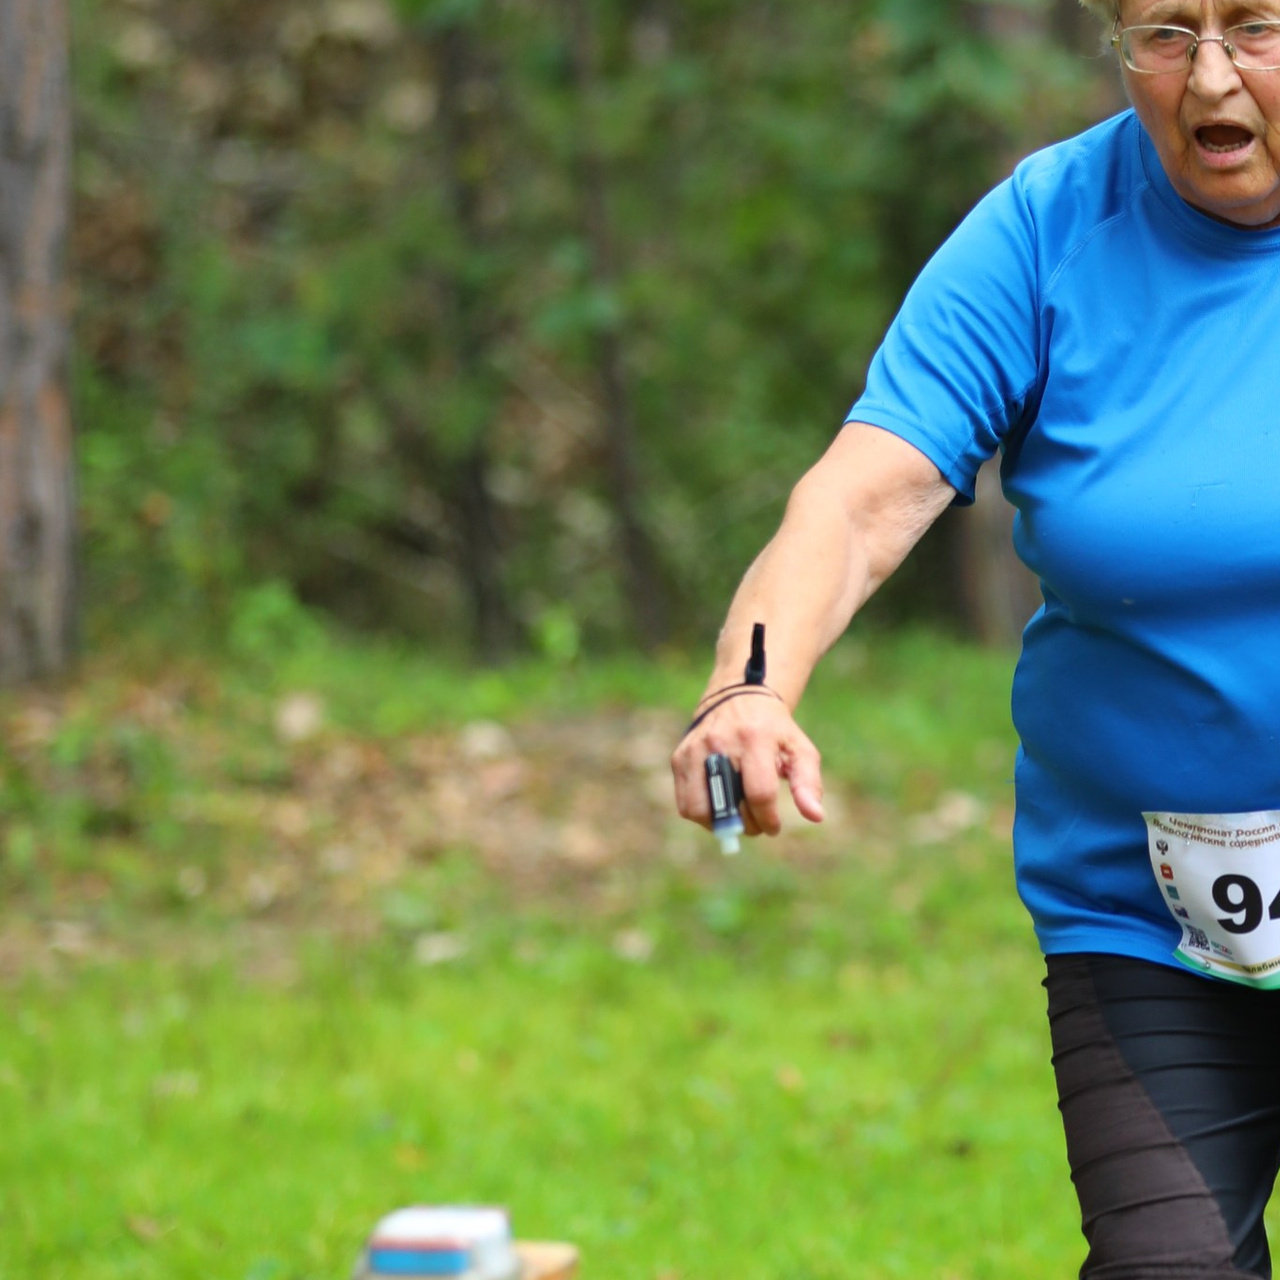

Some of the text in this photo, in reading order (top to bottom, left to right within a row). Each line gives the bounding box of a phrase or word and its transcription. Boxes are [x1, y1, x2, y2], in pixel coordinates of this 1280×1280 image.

[1153, 818, 1226, 847] Всероссийские
[1169, 817, 1232, 838] Чемпионат
[1236, 823, 1275, 838] России
